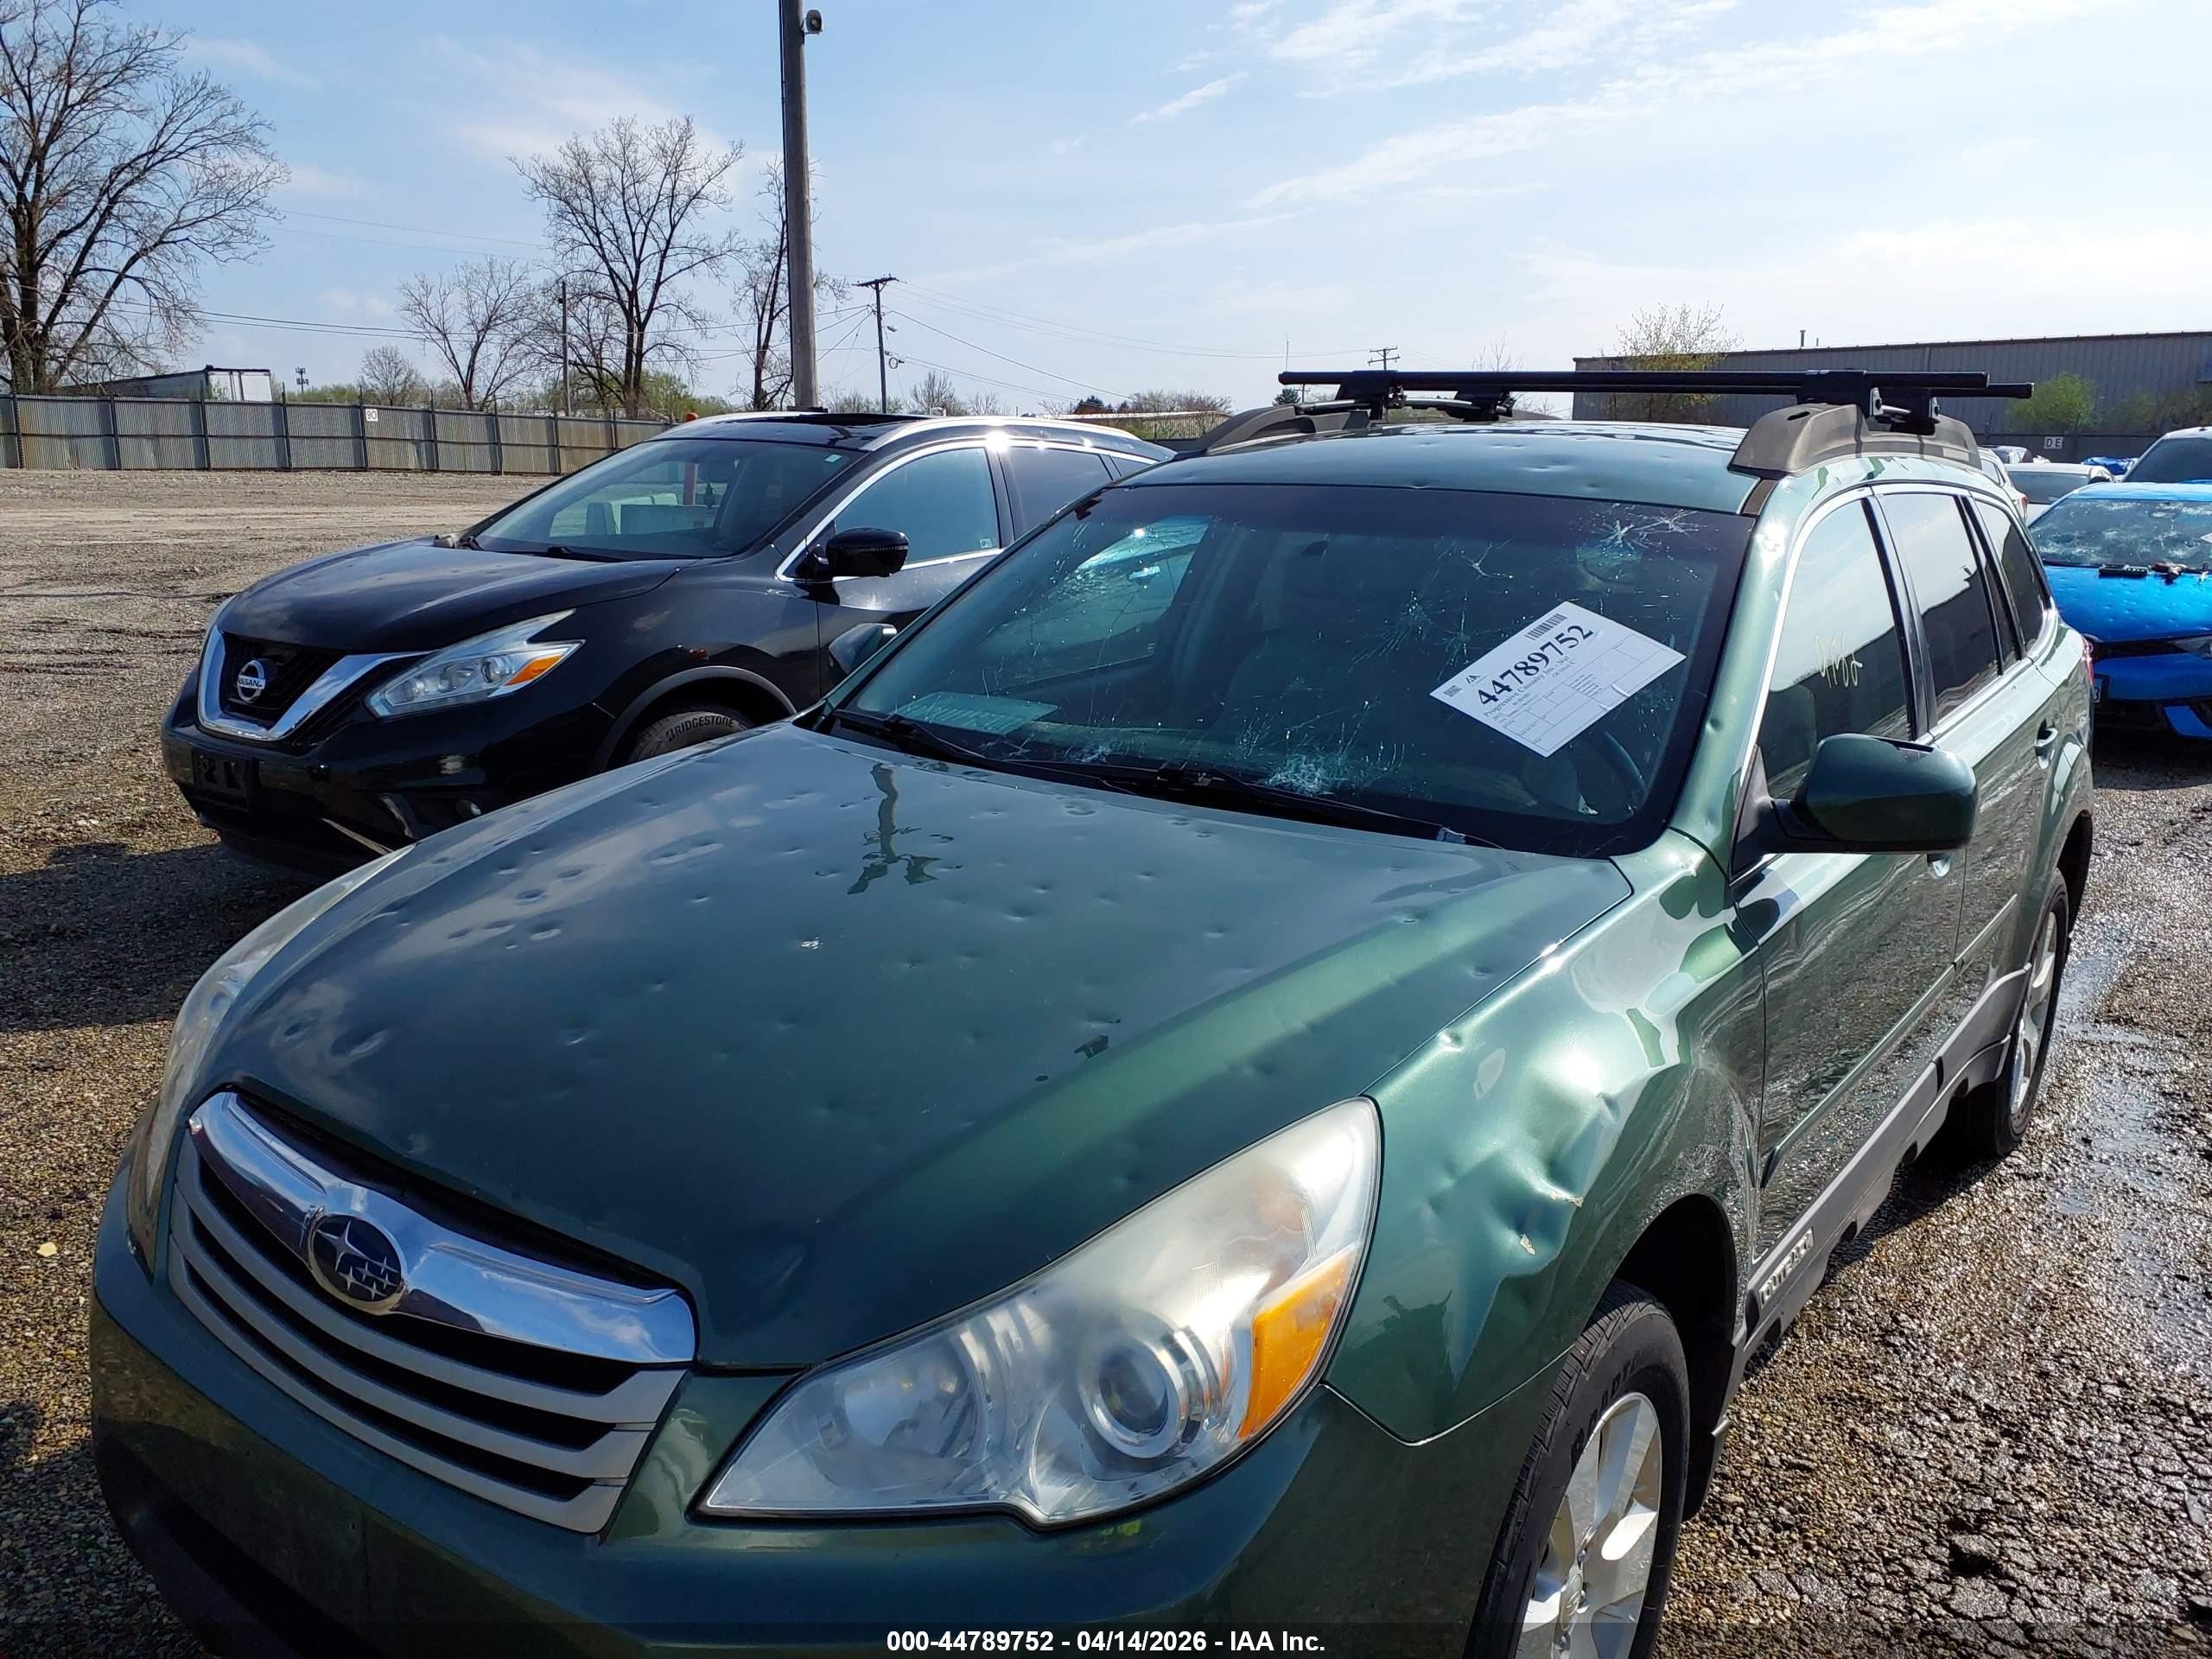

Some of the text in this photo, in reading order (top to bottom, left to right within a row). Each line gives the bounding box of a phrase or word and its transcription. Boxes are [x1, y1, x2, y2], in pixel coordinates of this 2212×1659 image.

[366, 410, 378, 420] 90
[1477, 625, 1594, 705] 44789752
[1483, 691, 1520, 717] Progressive
[665, 715, 734, 741] BRIDGESTONE
